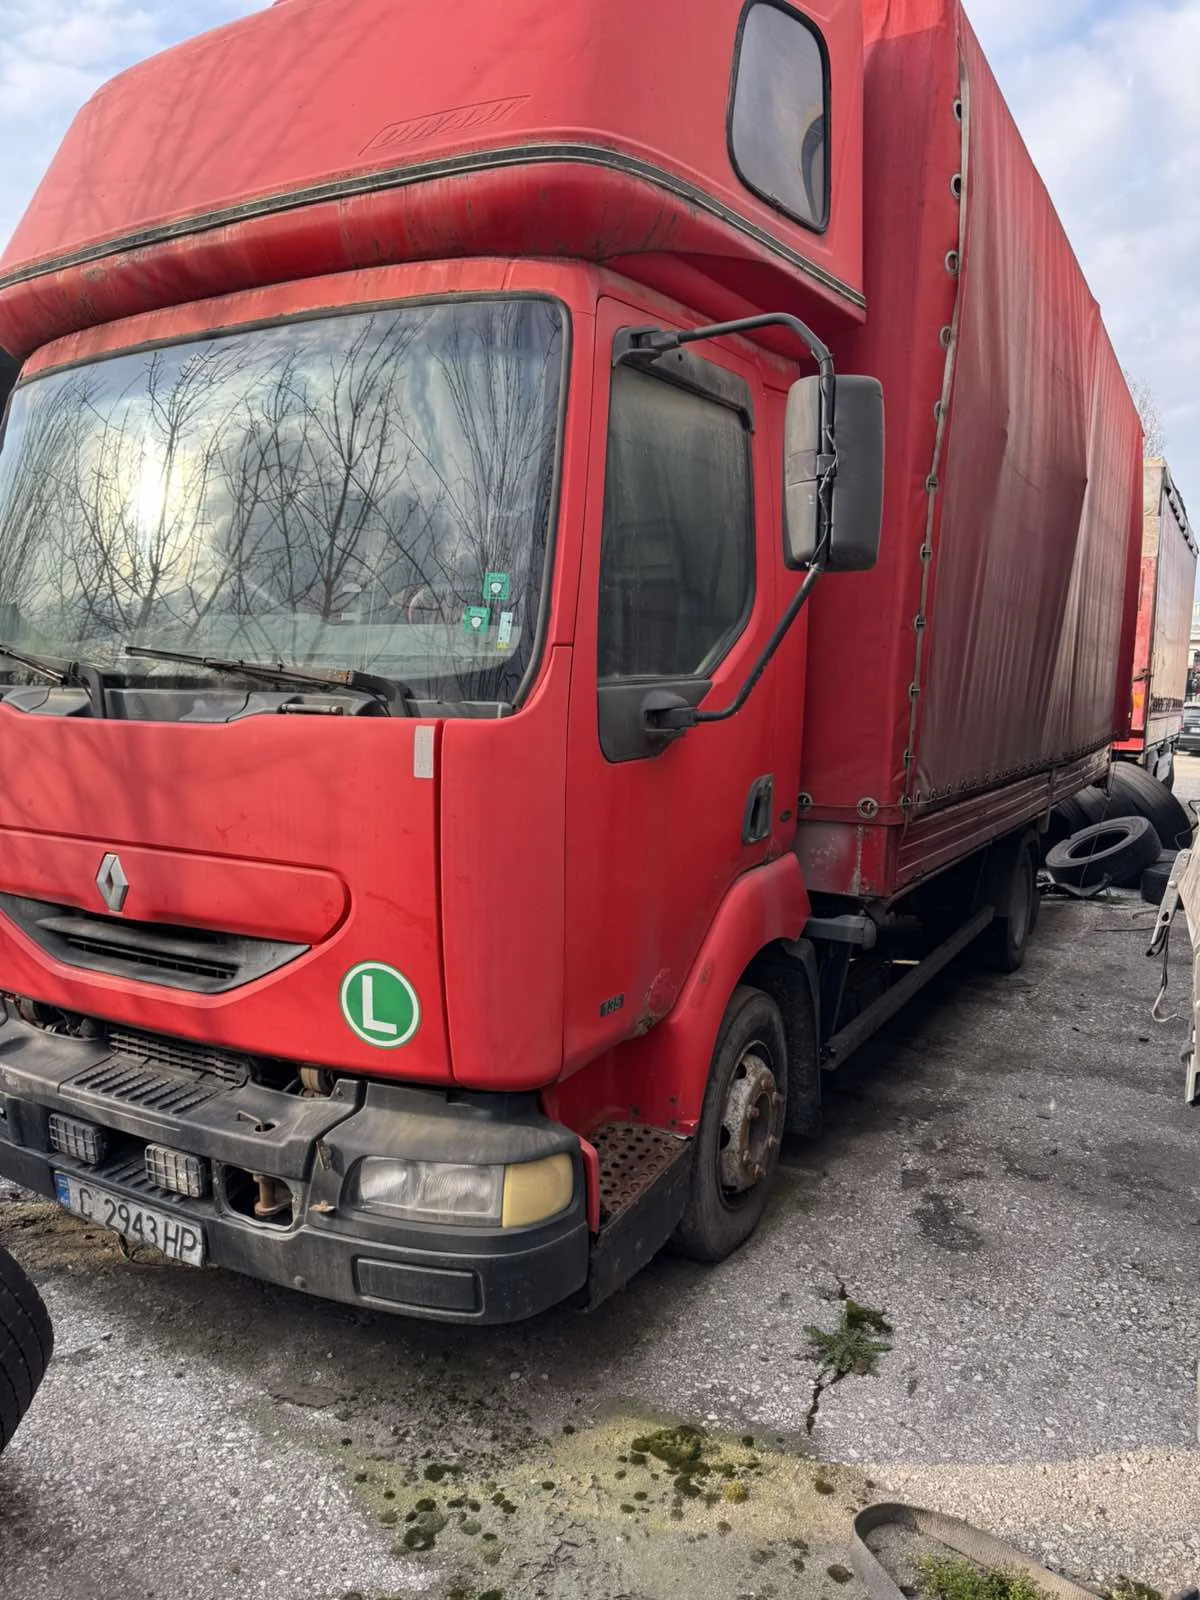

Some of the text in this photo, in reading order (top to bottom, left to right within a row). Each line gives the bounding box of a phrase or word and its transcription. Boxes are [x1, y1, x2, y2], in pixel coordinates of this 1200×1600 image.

[361, 974, 397, 1035] L
[105, 1199, 158, 1244] 2943
[164, 1222, 196, 1259] HP
